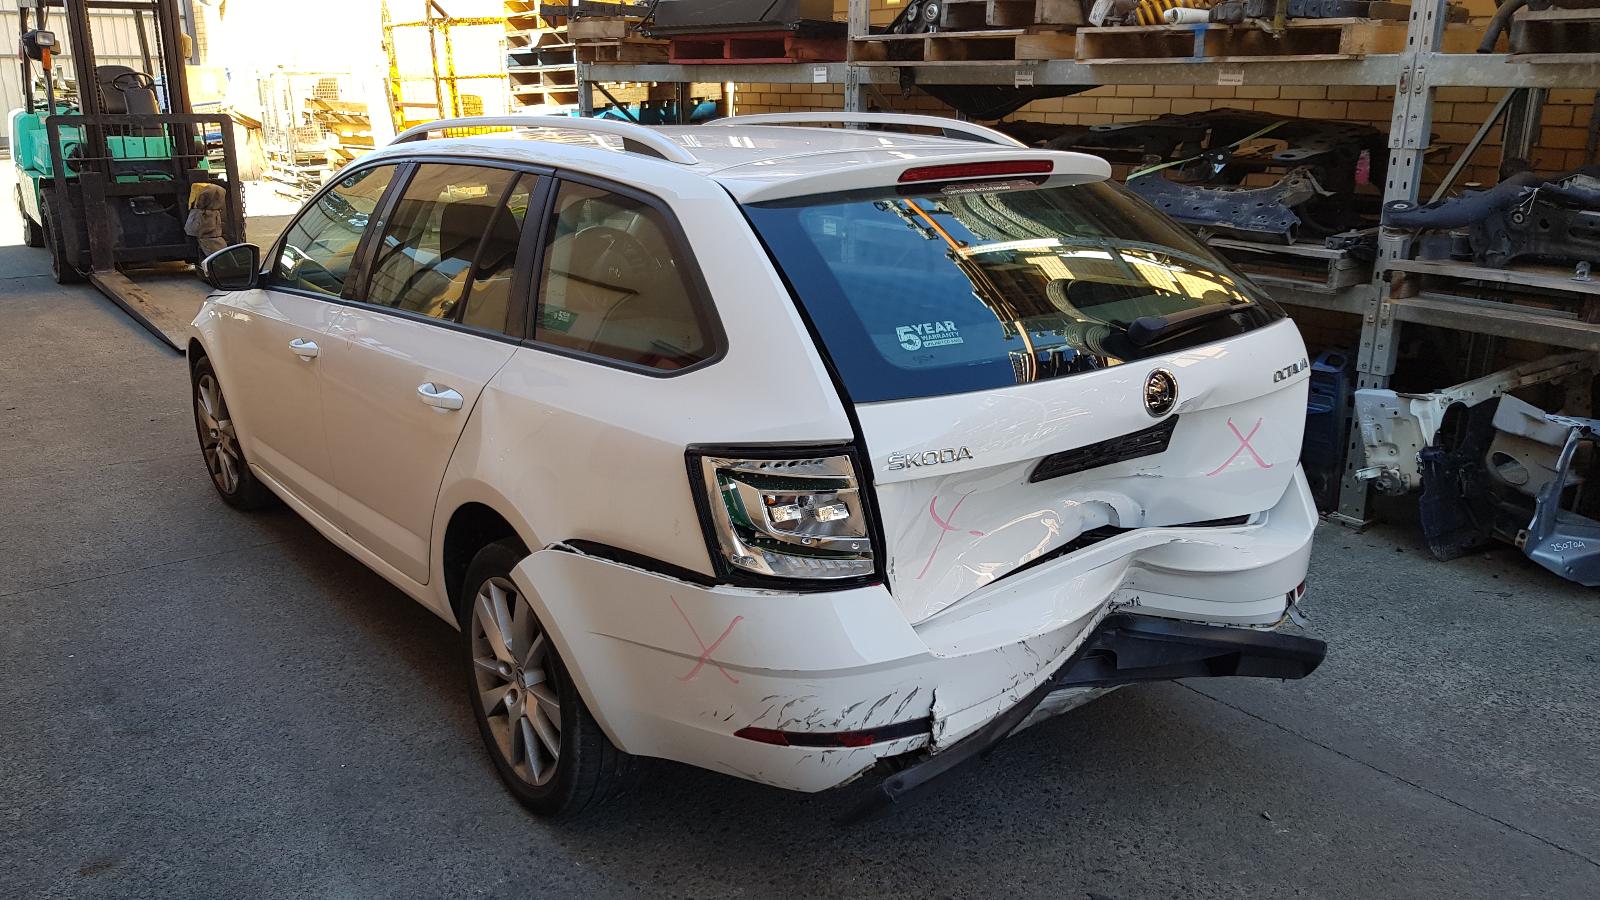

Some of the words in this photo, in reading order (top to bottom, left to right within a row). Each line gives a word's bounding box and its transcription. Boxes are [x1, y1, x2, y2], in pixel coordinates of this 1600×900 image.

[896, 326, 922, 351] 5
[911, 320, 958, 335] YEAR
[920, 331, 959, 341] WARRANTY
[888, 445, 974, 471] ŠKODA
[1550, 540, 1586, 551] 250704
